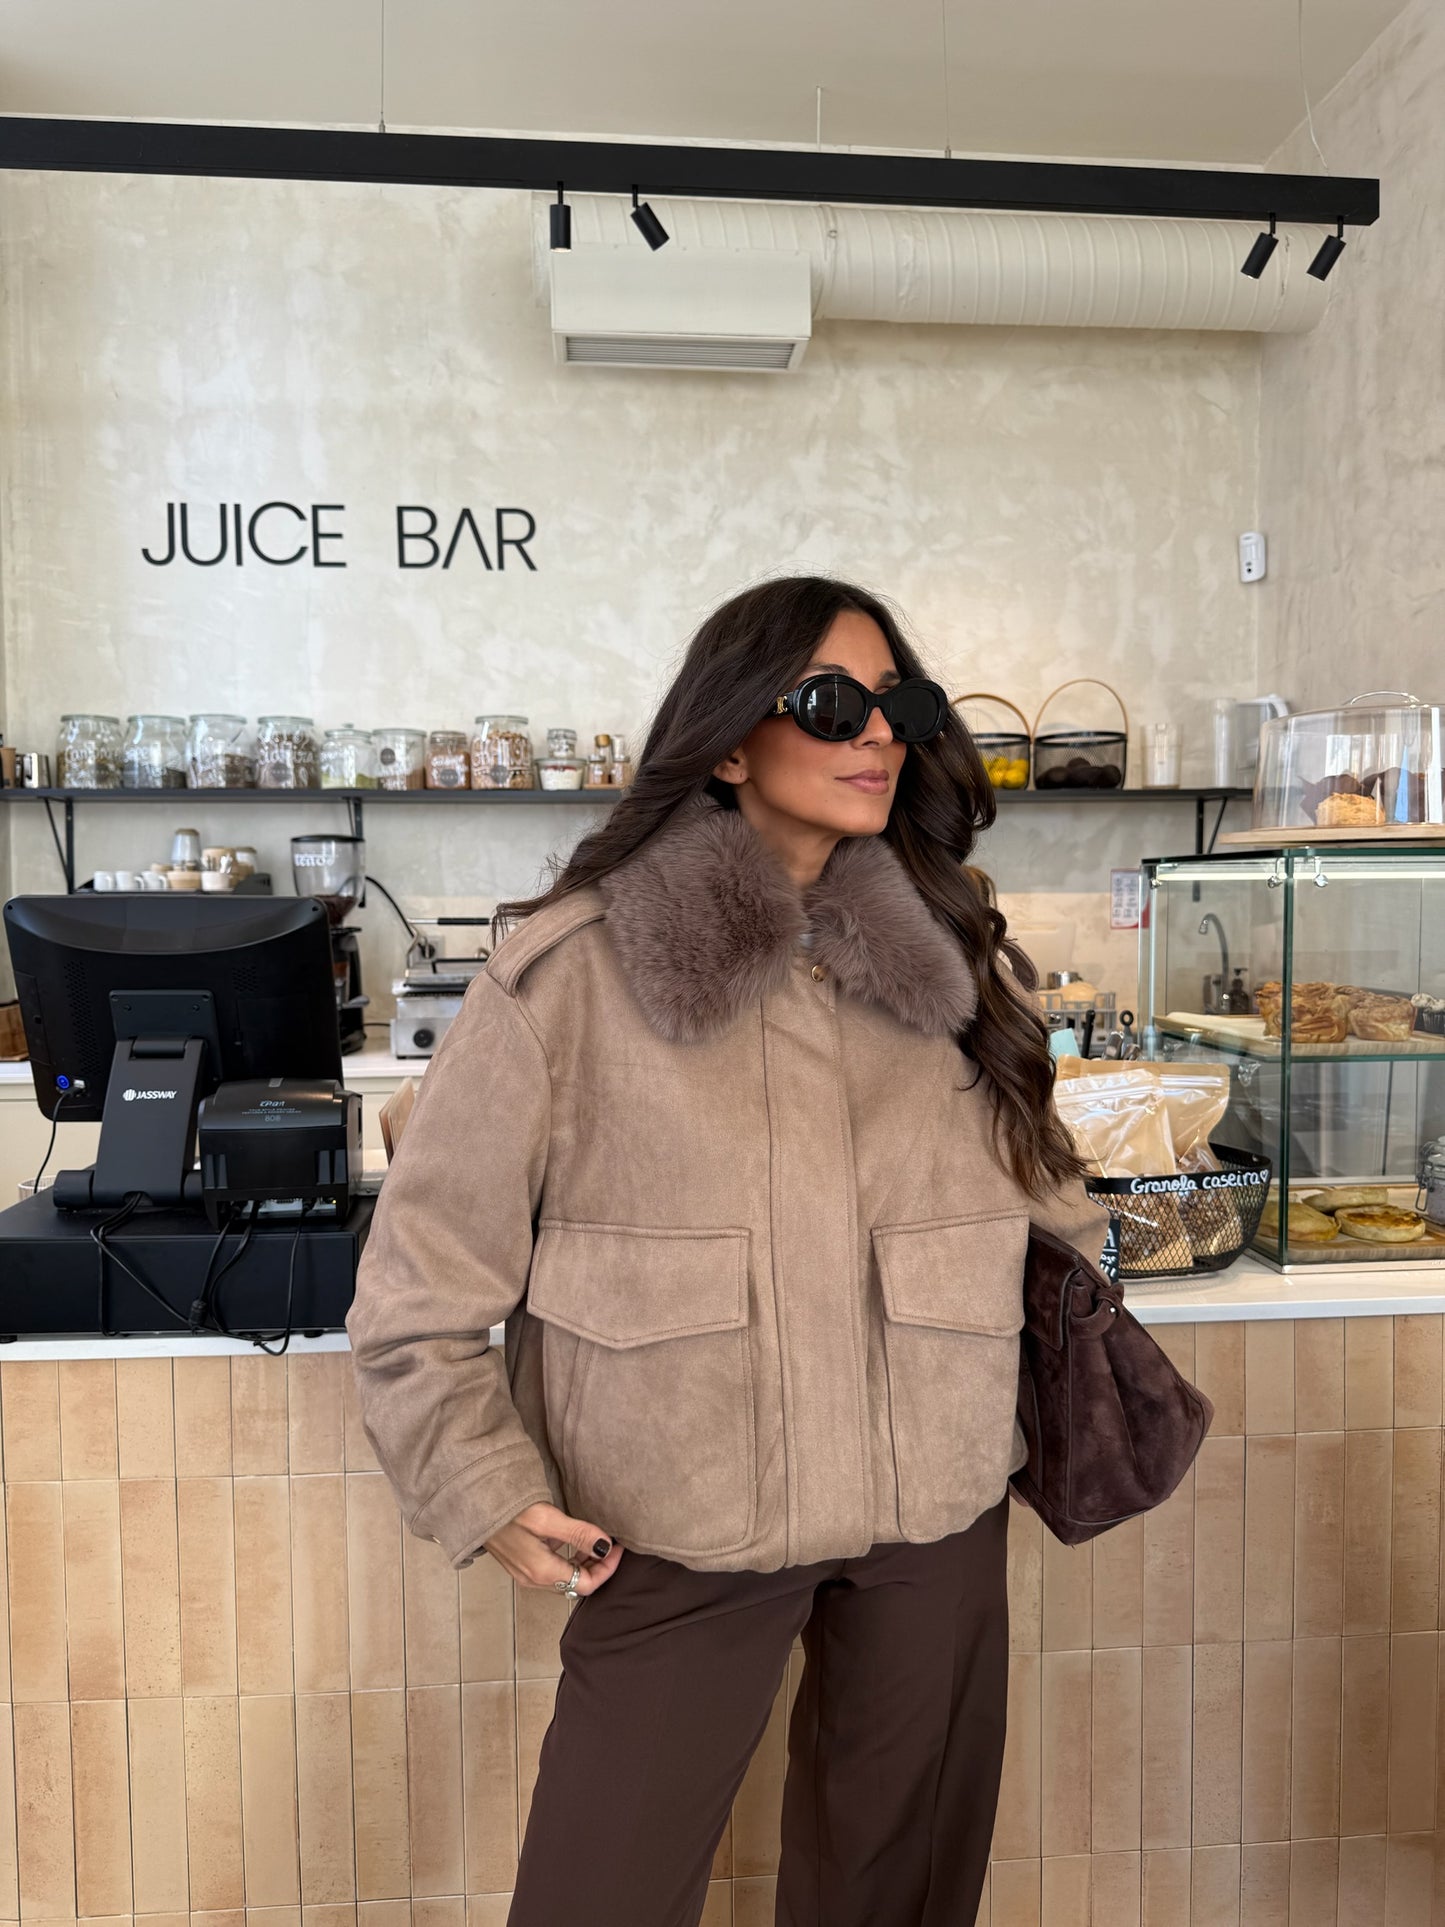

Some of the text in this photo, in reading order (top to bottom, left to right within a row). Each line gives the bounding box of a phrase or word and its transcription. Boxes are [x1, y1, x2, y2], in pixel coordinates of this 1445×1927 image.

[141, 501, 538, 571] JUICE BAR
[136, 1090, 177, 1100] JASSWAY
[1130, 1170, 1260, 1195] Granola caseira
